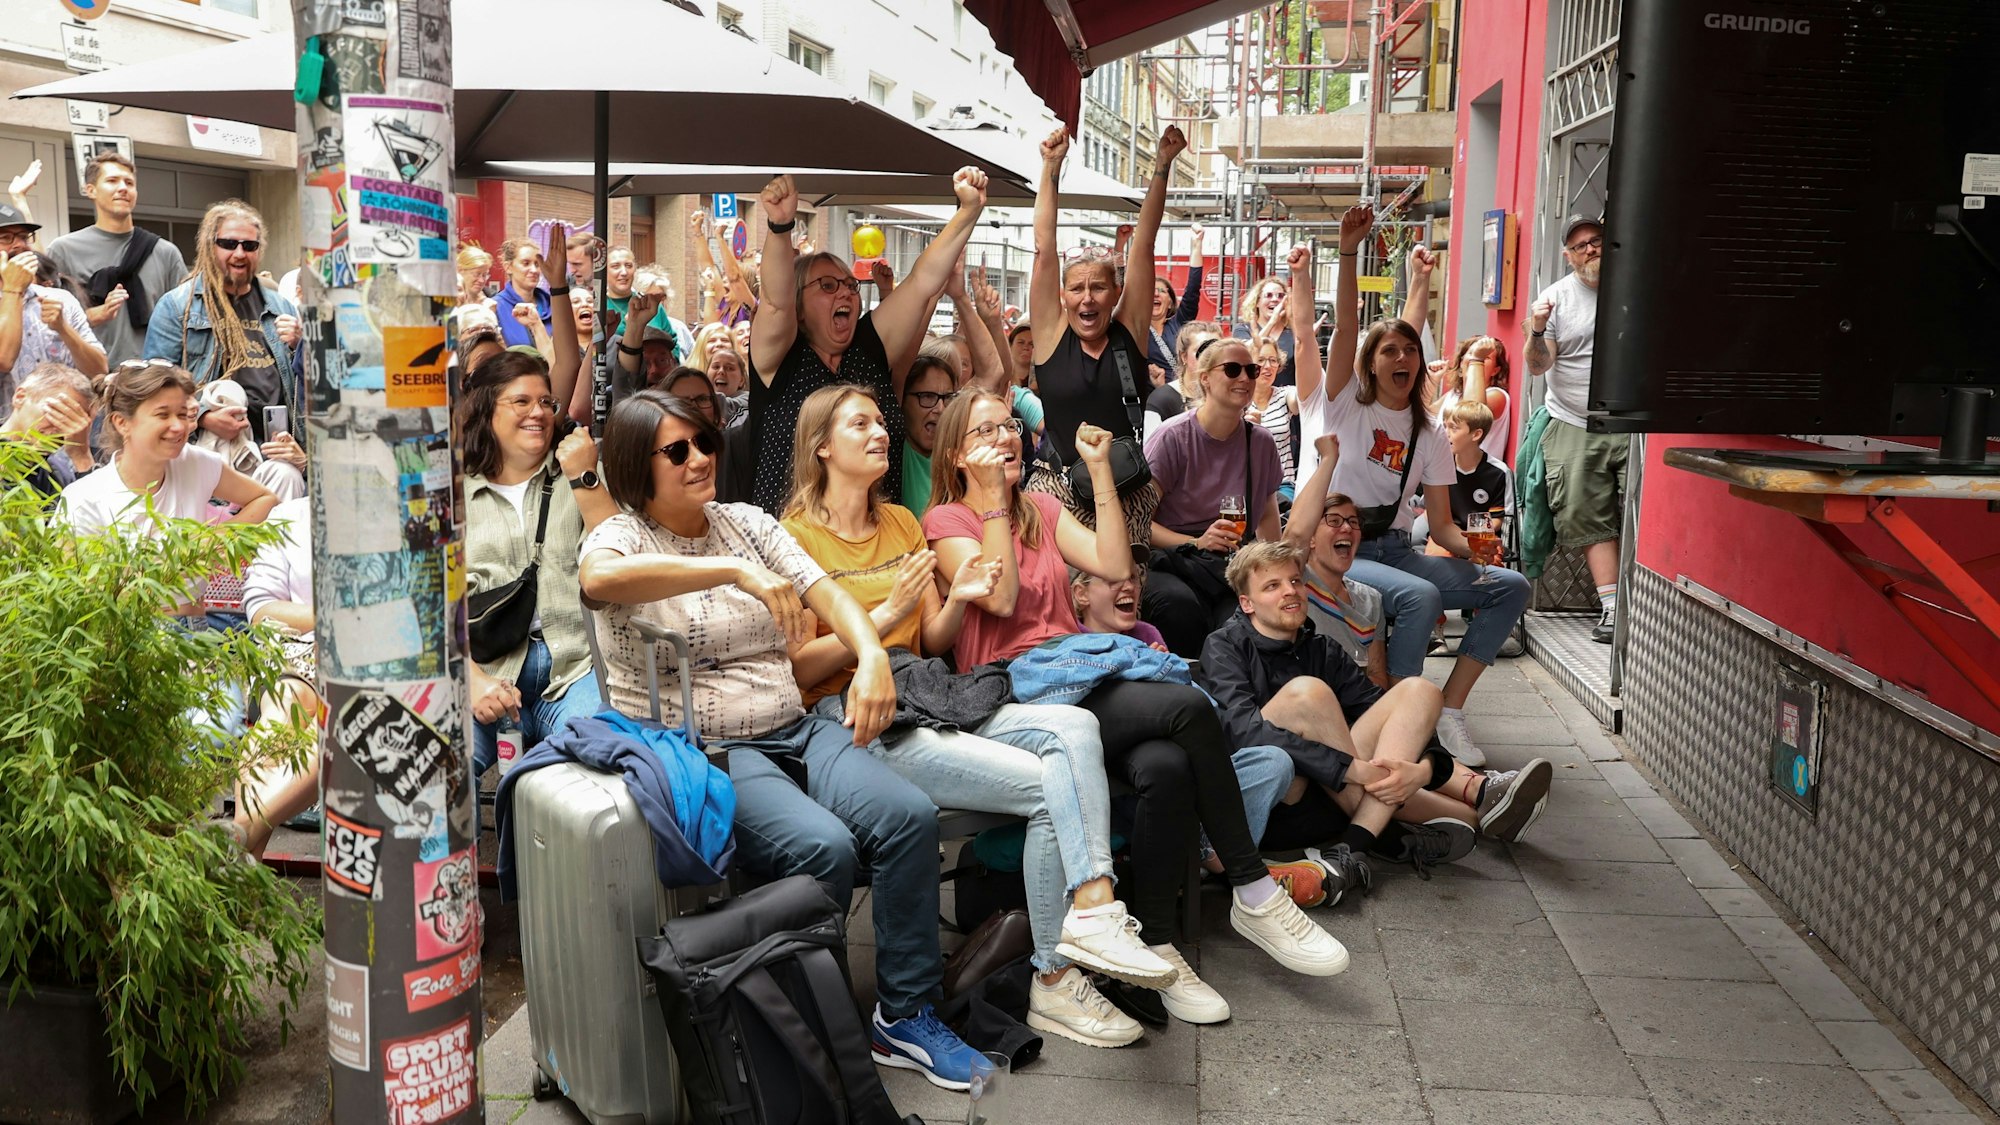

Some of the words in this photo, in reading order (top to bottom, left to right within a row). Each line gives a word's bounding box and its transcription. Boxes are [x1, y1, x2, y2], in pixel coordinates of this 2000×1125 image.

[1704, 13, 1810, 35] GRUNDIG
[362, 178, 440, 205] COCKTAILS
[718, 194, 732, 217] P
[340, 694, 392, 748] GEGEN
[394, 738, 442, 797] NAZIS
[325, 818, 381, 863] FCK
[324, 844, 374, 885] NZS
[410, 973, 455, 1001] Rote
[389, 1024, 468, 1070] SPORT
[394, 1065, 472, 1104] FORTUNA
[402, 1050, 464, 1087] CLUB
